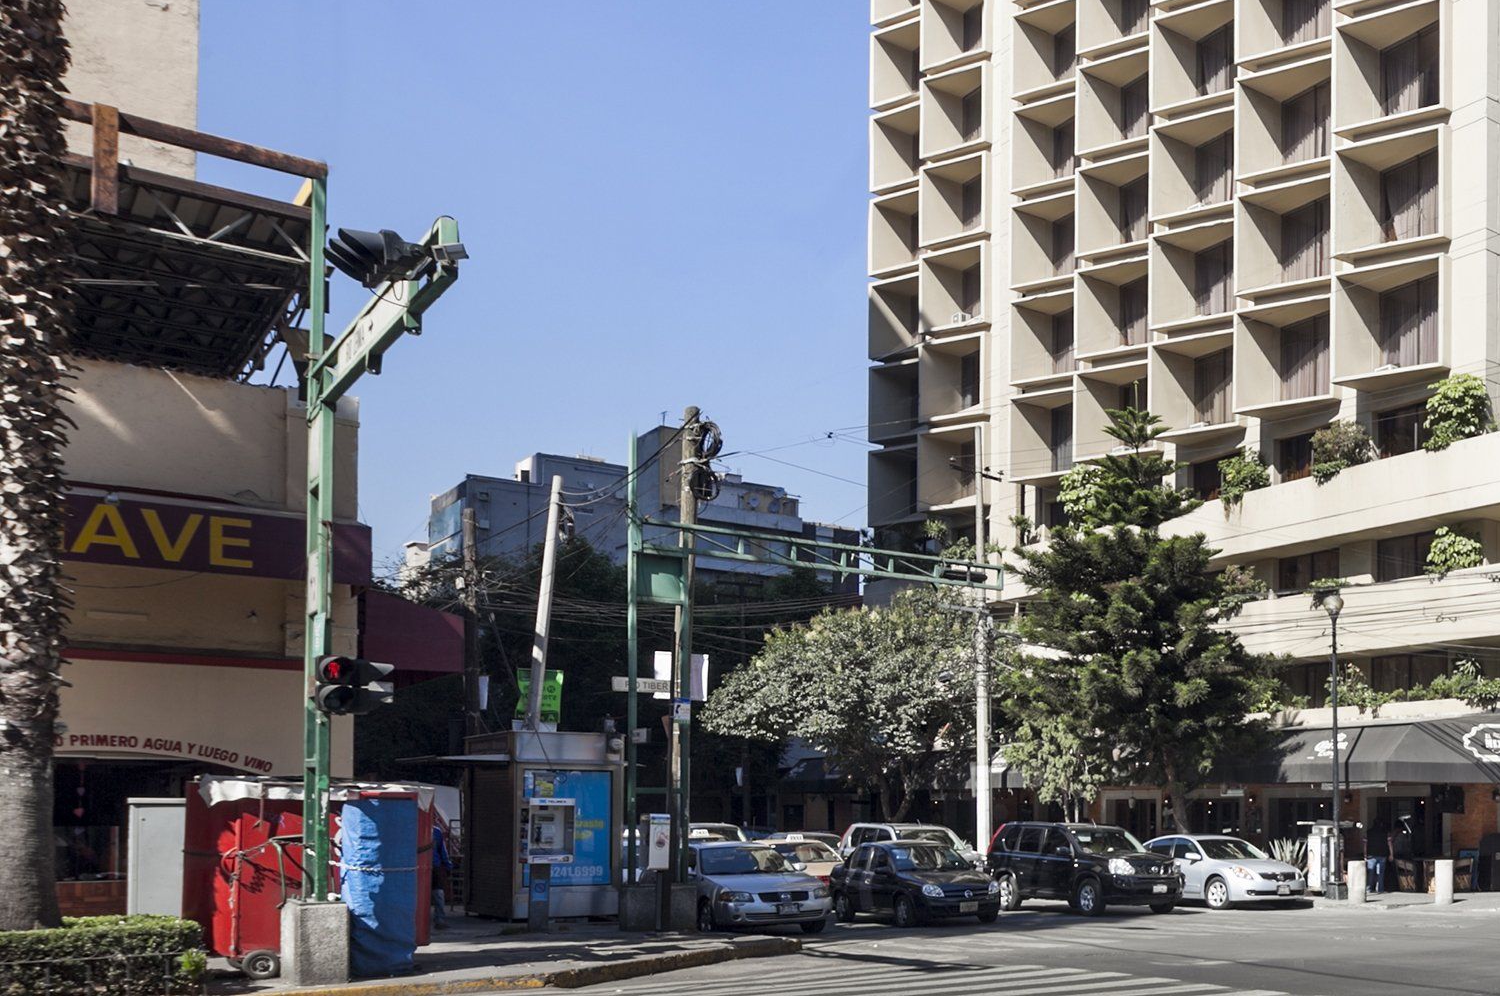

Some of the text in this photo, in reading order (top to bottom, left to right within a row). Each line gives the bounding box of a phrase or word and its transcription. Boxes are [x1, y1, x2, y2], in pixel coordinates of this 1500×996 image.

[58, 503, 254, 569] AVE
[69, 734, 138, 748] PRIMERO
[143, 738, 182, 753] AGUA
[187, 742, 199, 754] Y
[198, 745, 239, 764] LUEGO
[243, 755, 273, 773] VINO
